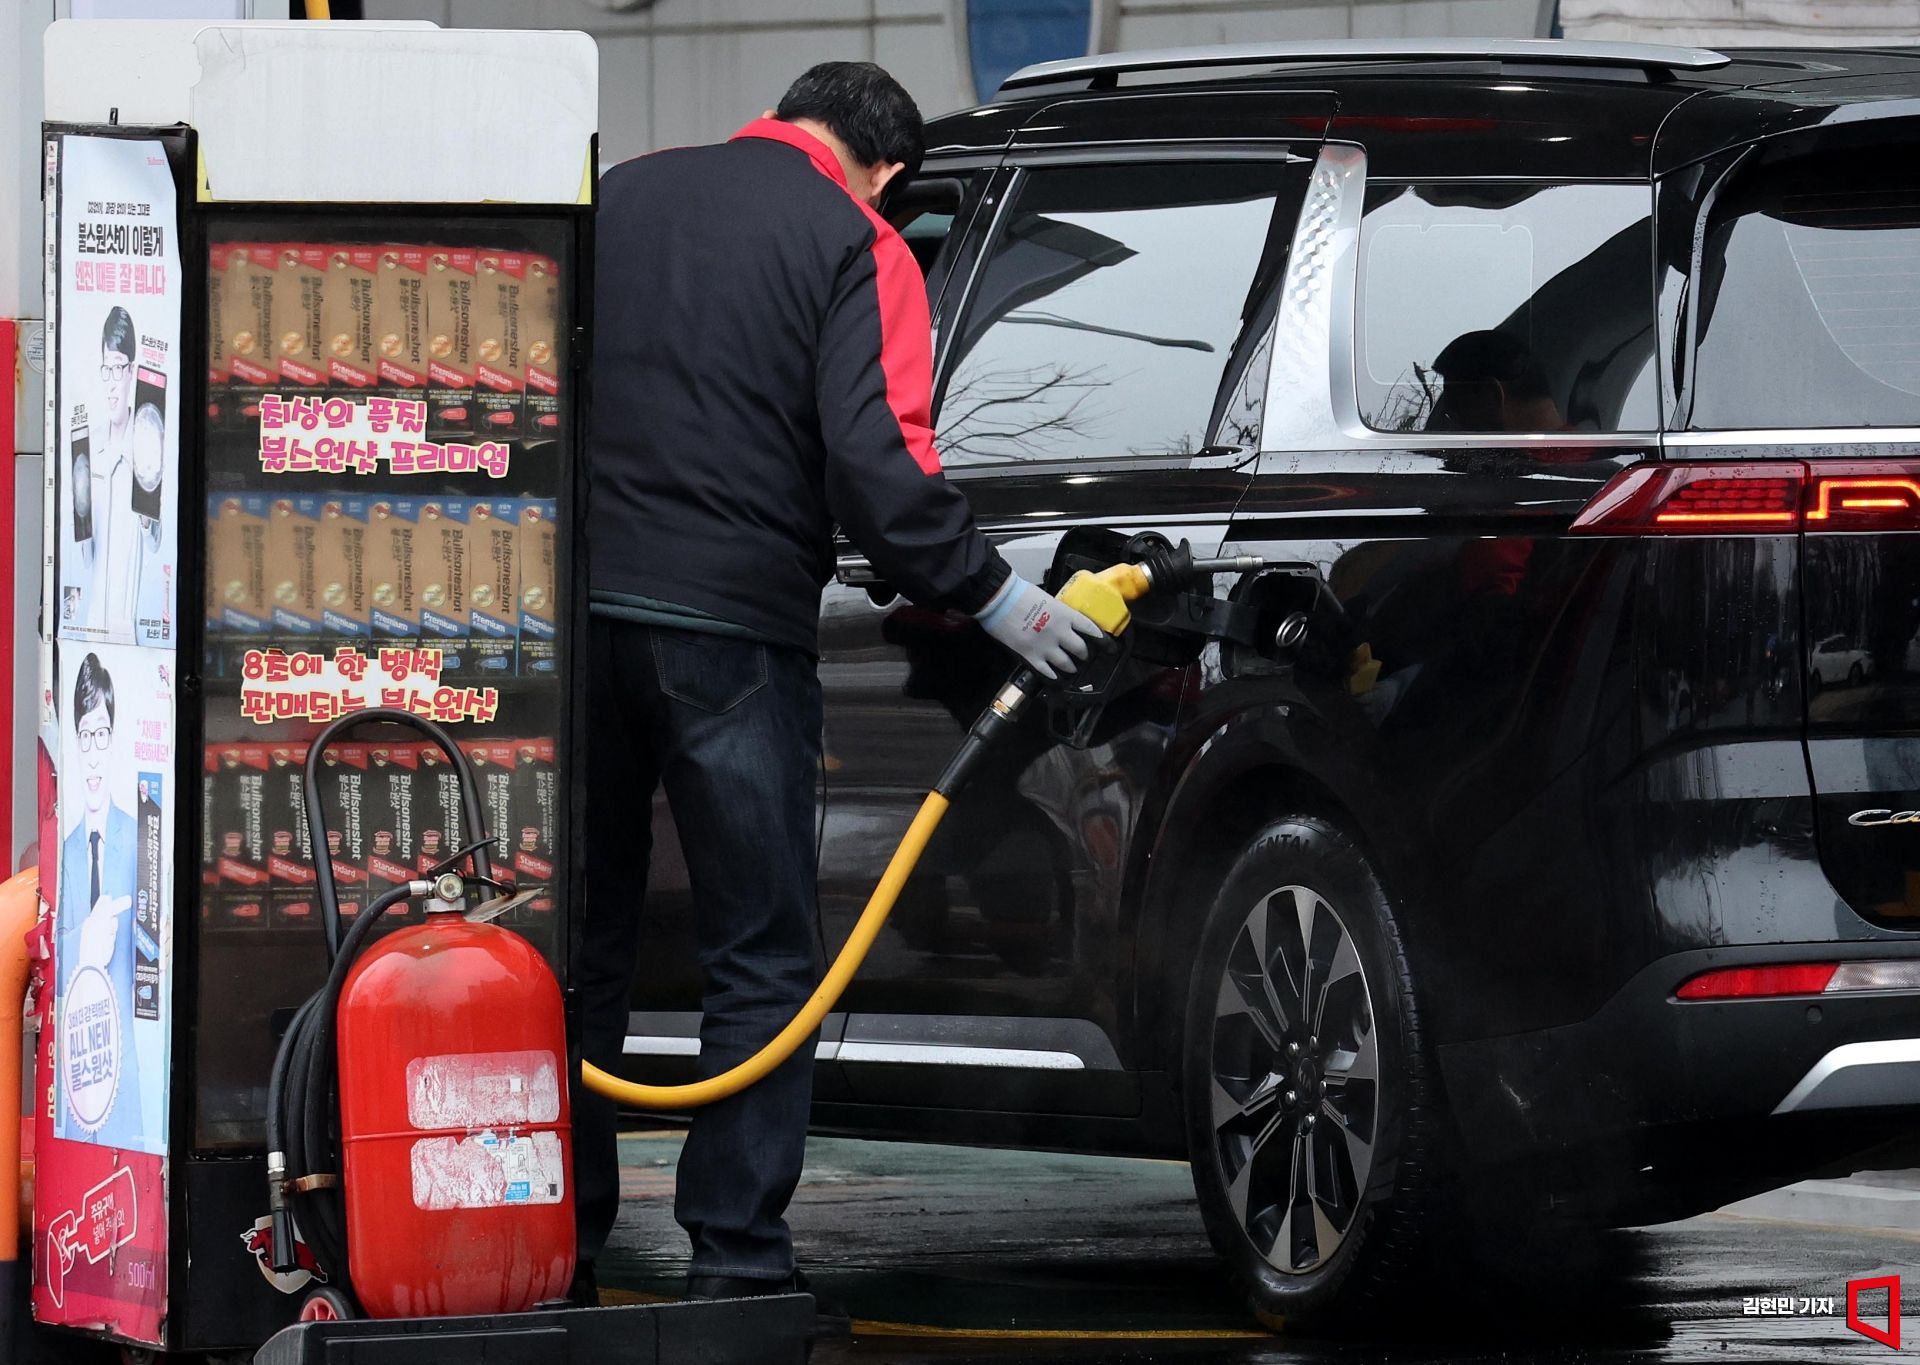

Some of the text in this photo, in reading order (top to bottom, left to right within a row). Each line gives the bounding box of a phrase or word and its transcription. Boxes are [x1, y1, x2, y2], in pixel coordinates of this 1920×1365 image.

[78, 222, 164, 257] 불스원샷이 이렇게
[75, 261, 94, 291] 엔진
[119, 262, 132, 294] 잘
[411, 278, 421, 364] Bullsoneshot
[459, 280, 470, 364] Bullsoneshot
[260, 394, 426, 433] 최상의 품질
[261, 435, 508, 476] 불스원샷 프리미엄
[452, 529, 463, 613] Bullsoneshot
[501, 530, 513, 614] Bullsoneshot
[423, 611, 458, 632] Premium
[472, 612, 506, 633] Premium
[1032, 611, 1050, 633] 3M
[242, 647, 441, 682] 8초에 한 병씩
[242, 687, 497, 722] 판매되는 불스원샷
[339, 774, 349, 808] 불스원샷
[389, 774, 400, 809] 불스원샷
[438, 773, 449, 808] 불스원샷
[251, 775, 263, 860] Bullsoneshot
[350, 774, 362, 860] Bullsoneshot
[400, 774, 412, 860] Bullsoneshot
[449, 774, 461, 857] Bullsonesho
[499, 774, 510, 860] Bullsoneshot
[272, 859, 307, 878] Standard
[373, 859, 406, 878] Standard
[70, 1018, 111, 1060] ALL NEW
[71, 1049, 113, 1092] 불스원샷
[128, 1261, 155, 1290] 500ml
